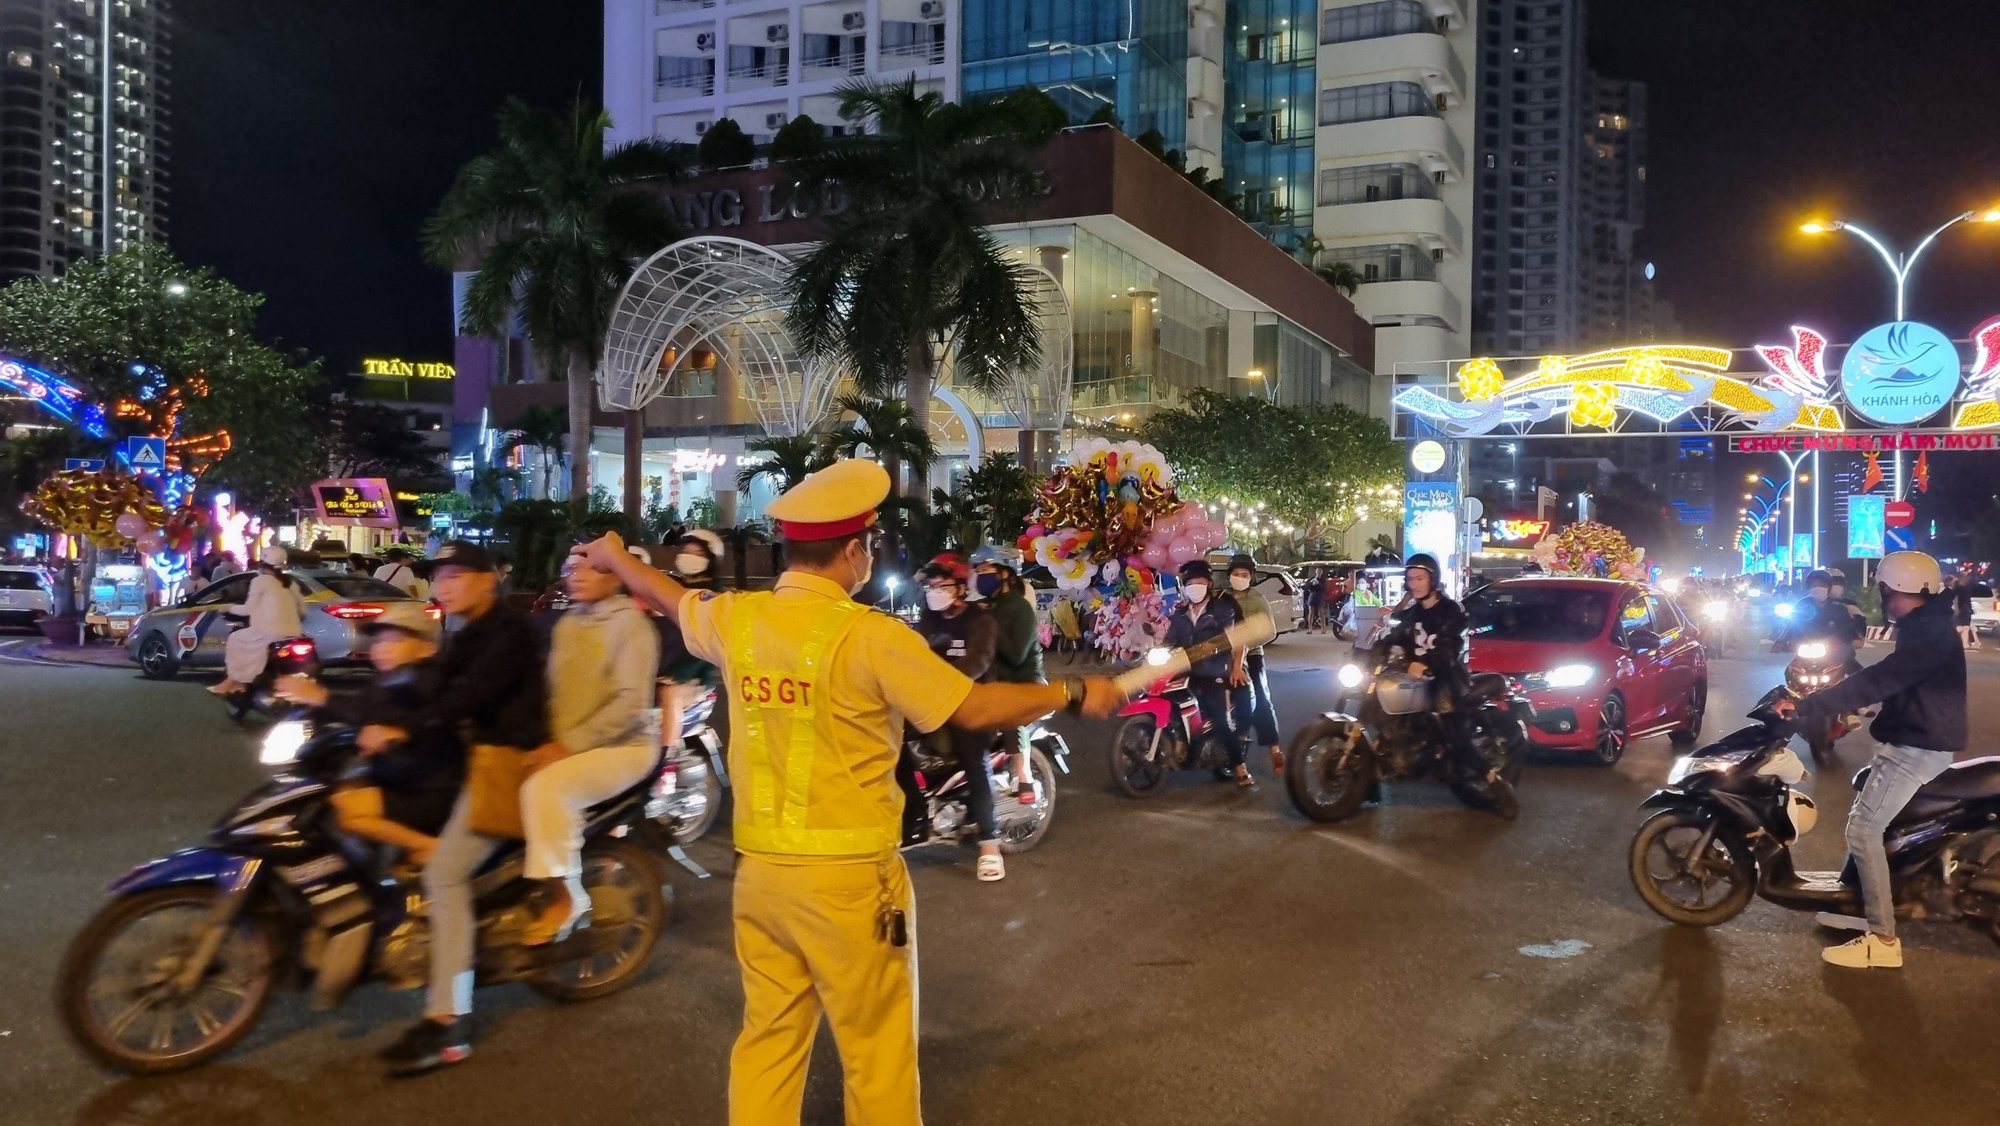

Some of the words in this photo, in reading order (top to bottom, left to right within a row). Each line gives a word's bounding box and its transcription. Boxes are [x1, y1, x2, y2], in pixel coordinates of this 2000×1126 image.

[1862, 394, 1909, 407] KHÁNH
[1912, 392, 1941, 405] HÒA
[741, 675, 811, 707] CSGT
